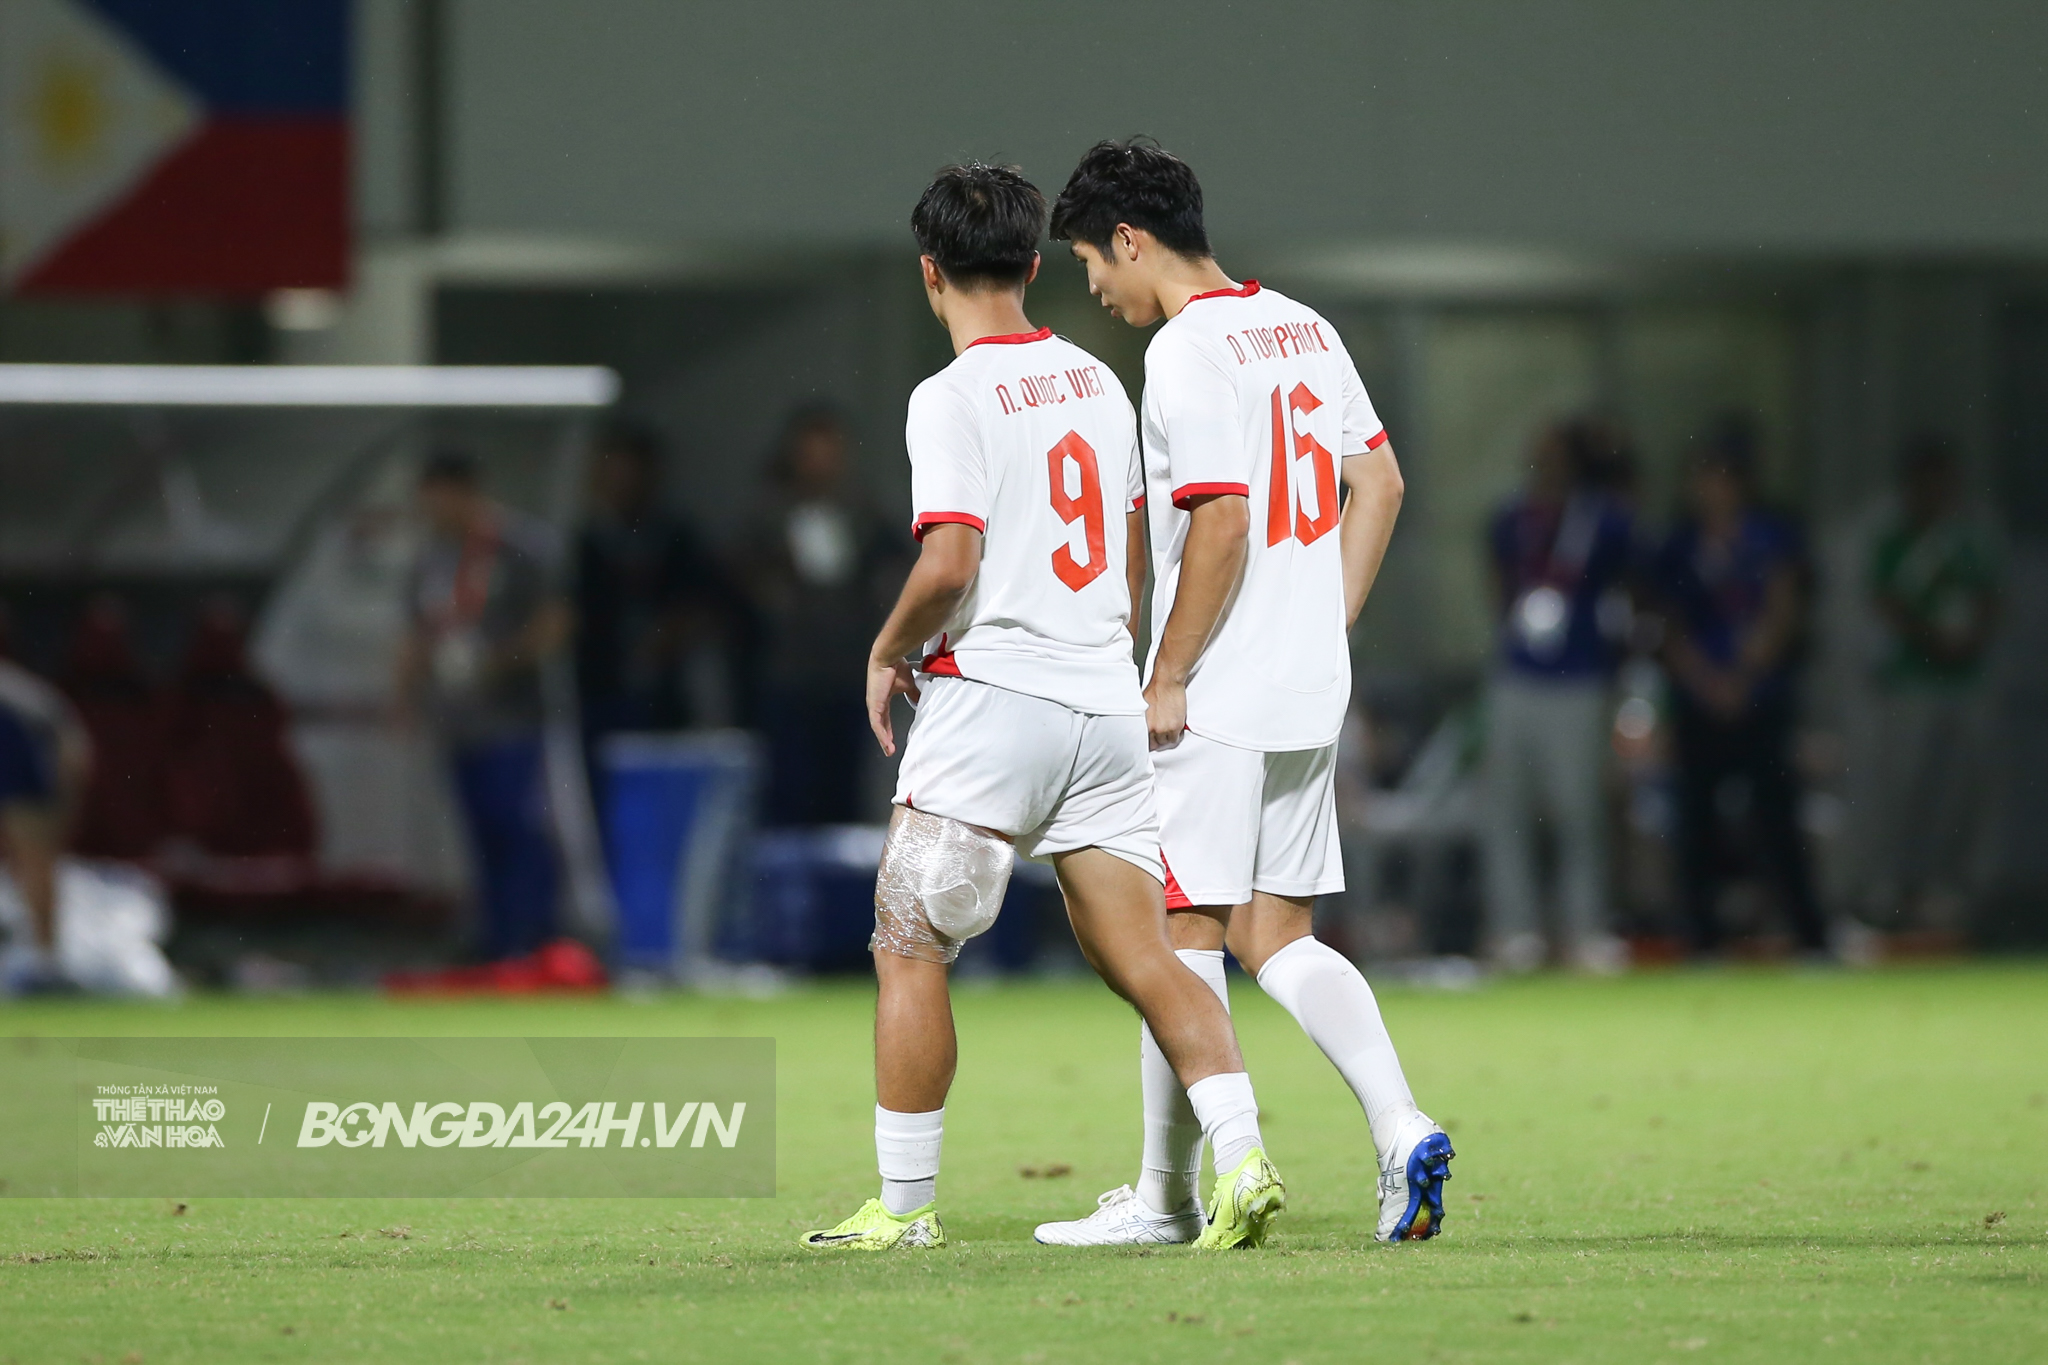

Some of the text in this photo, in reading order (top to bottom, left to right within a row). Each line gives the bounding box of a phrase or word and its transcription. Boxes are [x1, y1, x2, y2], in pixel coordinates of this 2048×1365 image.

[1018, 374, 1066, 408] QUOC
[1064, 366, 1105, 399] VIET
[1226, 334, 1252, 365] D.
[1241, 326, 1279, 361] TUA
[1047, 428, 1108, 593] 9
[1267, 381, 1340, 548] 16
